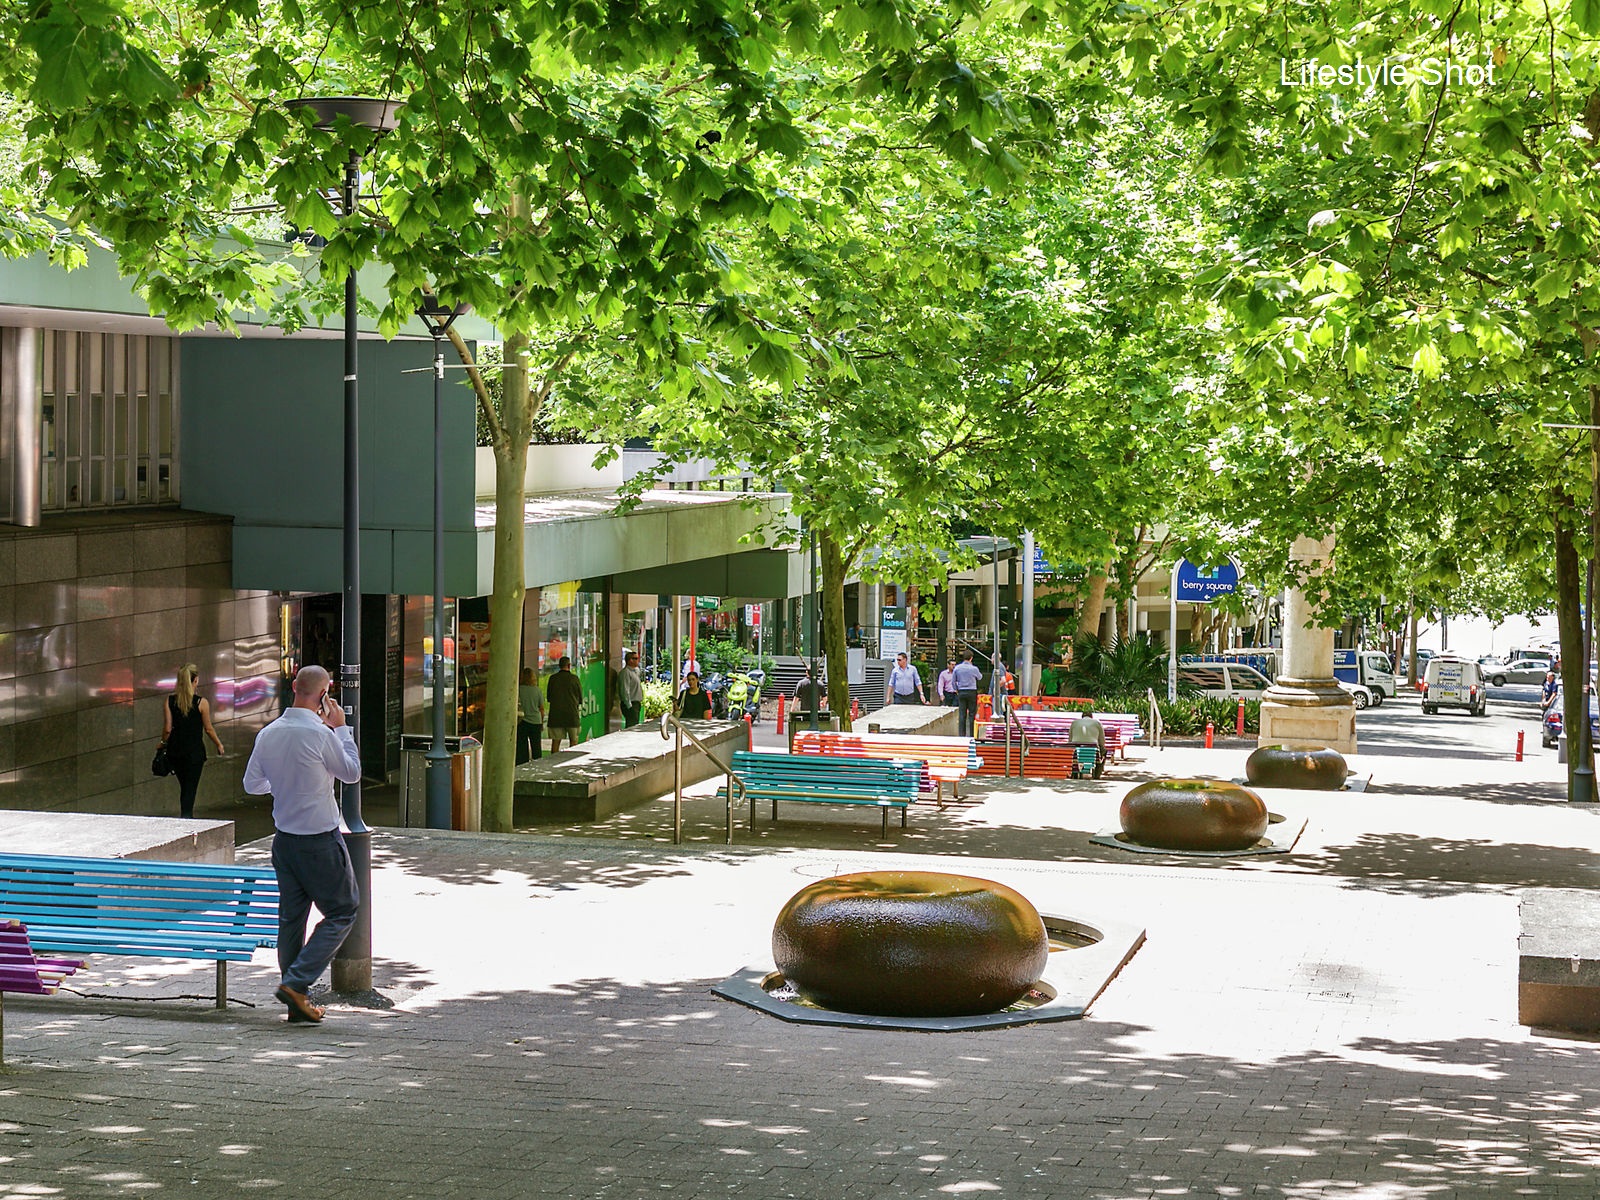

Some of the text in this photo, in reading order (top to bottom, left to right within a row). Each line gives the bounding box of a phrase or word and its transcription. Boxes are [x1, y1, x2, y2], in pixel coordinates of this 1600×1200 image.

[1182, 579, 1233, 593] berry square
[883, 610, 895, 620] for
[883, 618, 905, 627] lease
